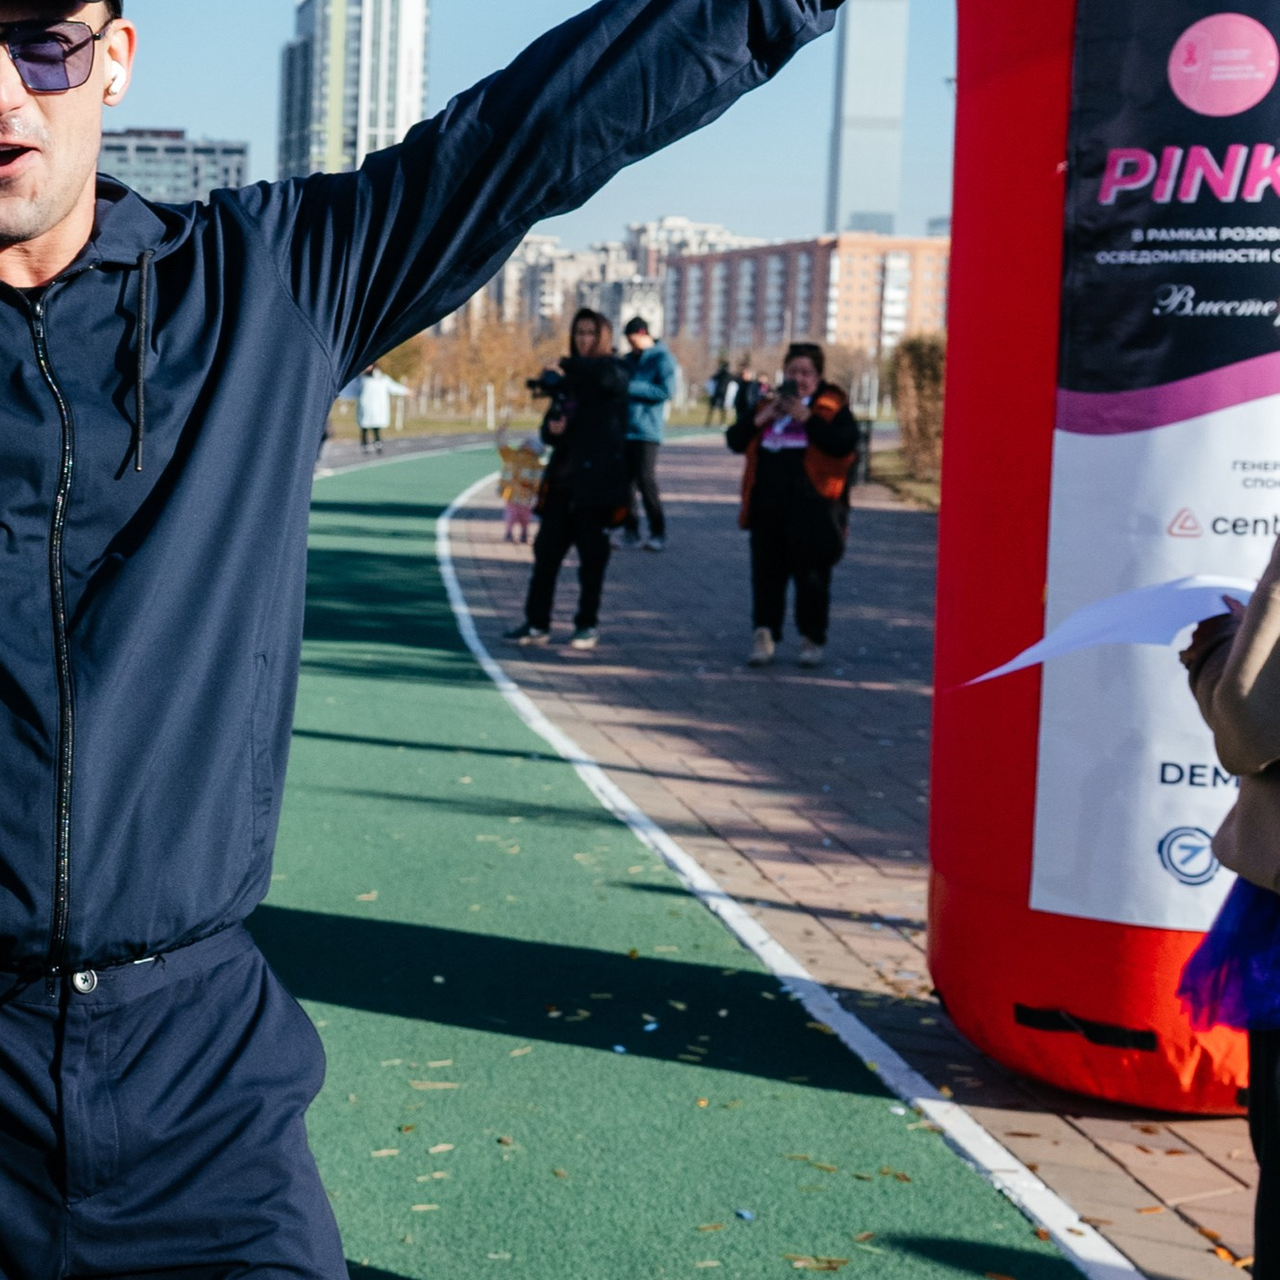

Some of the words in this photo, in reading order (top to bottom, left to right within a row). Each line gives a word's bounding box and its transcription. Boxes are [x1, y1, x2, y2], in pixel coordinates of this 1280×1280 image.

[1097, 143, 1280, 206] PINK
[1146, 227, 1218, 242] РАМКАХ
[1219, 226, 1280, 242] РОЗОВ
